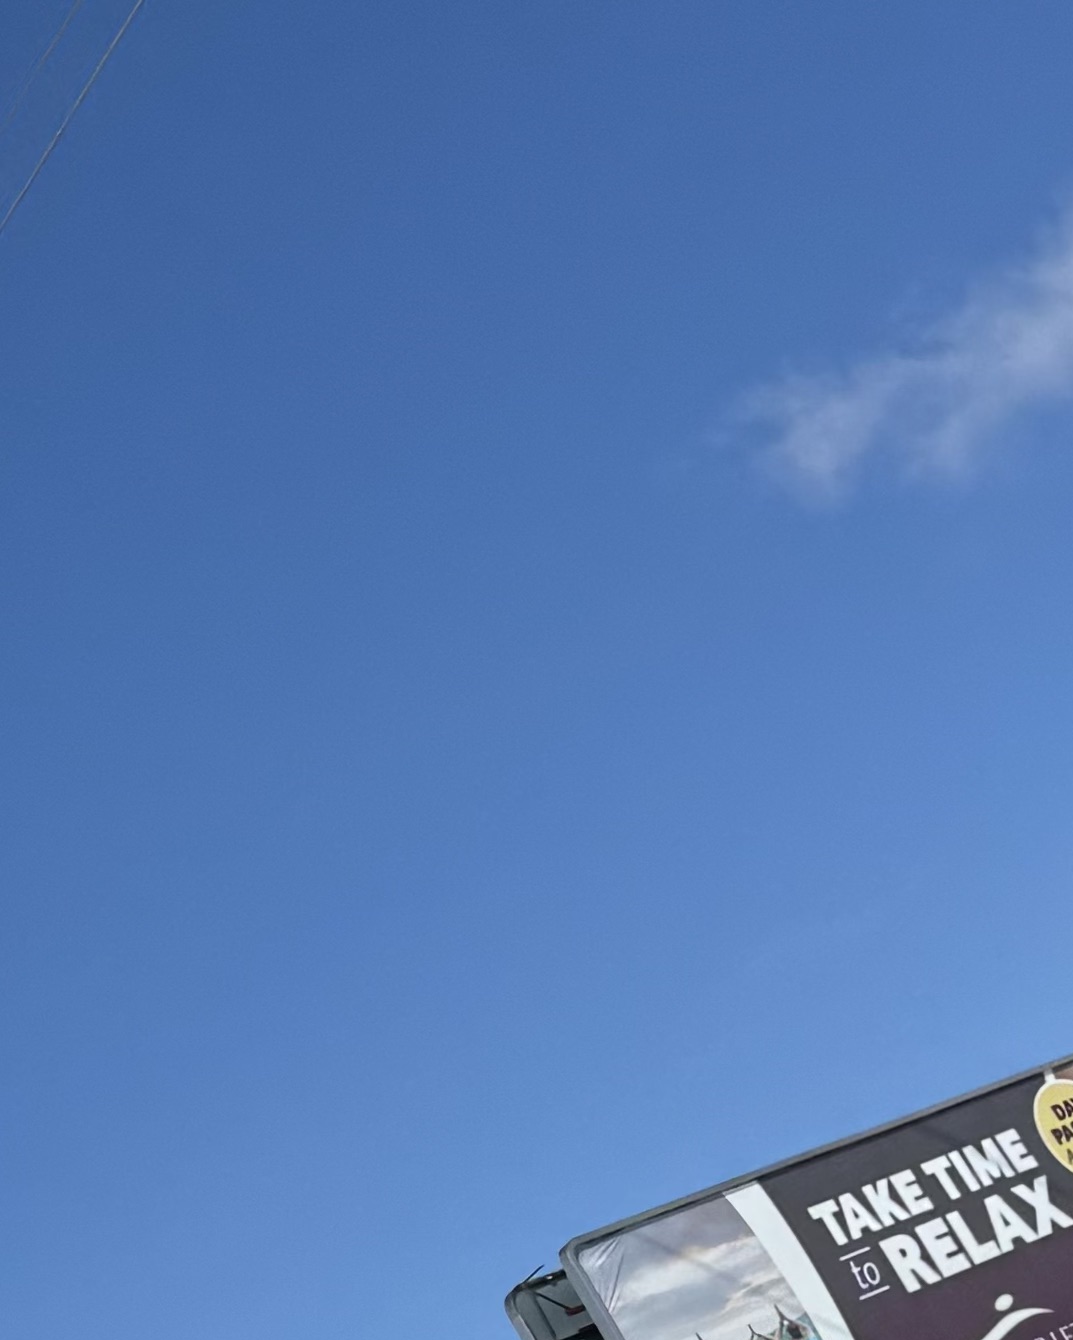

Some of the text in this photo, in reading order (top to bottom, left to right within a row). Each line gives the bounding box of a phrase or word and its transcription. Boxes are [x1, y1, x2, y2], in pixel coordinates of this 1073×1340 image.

[807, 1128, 1040, 1246] TAKE TIME
[850, 1260, 881, 1290] to
